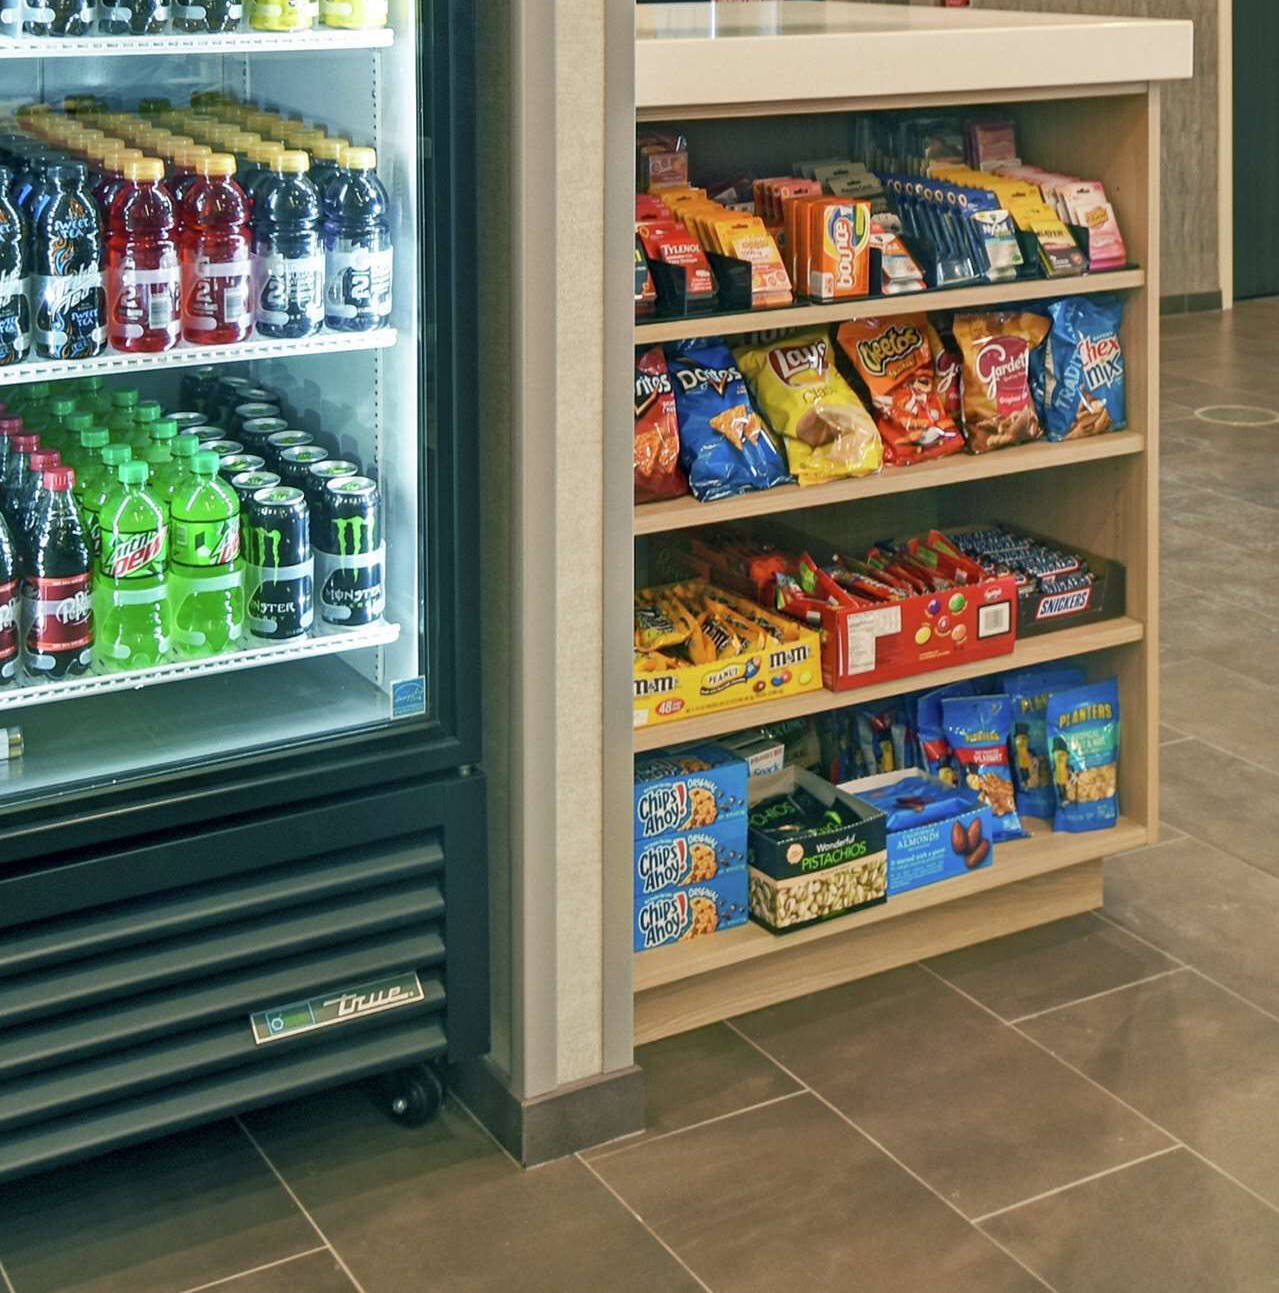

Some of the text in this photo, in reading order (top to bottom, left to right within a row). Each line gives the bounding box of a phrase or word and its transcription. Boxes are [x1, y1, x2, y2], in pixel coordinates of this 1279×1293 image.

[55, 218, 89, 231] SWEET
[61, 229, 84, 239] TEA
[661, 244, 700, 255] TYLENOL
[777, 342, 827, 378] Lay's
[636, 372, 671, 396] ritos
[676, 366, 743, 390] Doritos
[253, 601, 295, 614] NSTER
[1040, 591, 1087, 615] SNICKERS
[708, 667, 738, 684] PEANUT
[658, 700, 672, 713] 48
[1059, 702, 1112, 729] PLANTERS
[639, 788, 677, 820] Chips
[816, 834, 856, 853] Wonderful
[897, 831, 940, 849] ALMONDS
[639, 844, 677, 876] Chips
[802, 841, 866, 871] PISTACHIOS
[639, 898, 677, 930] Chips
